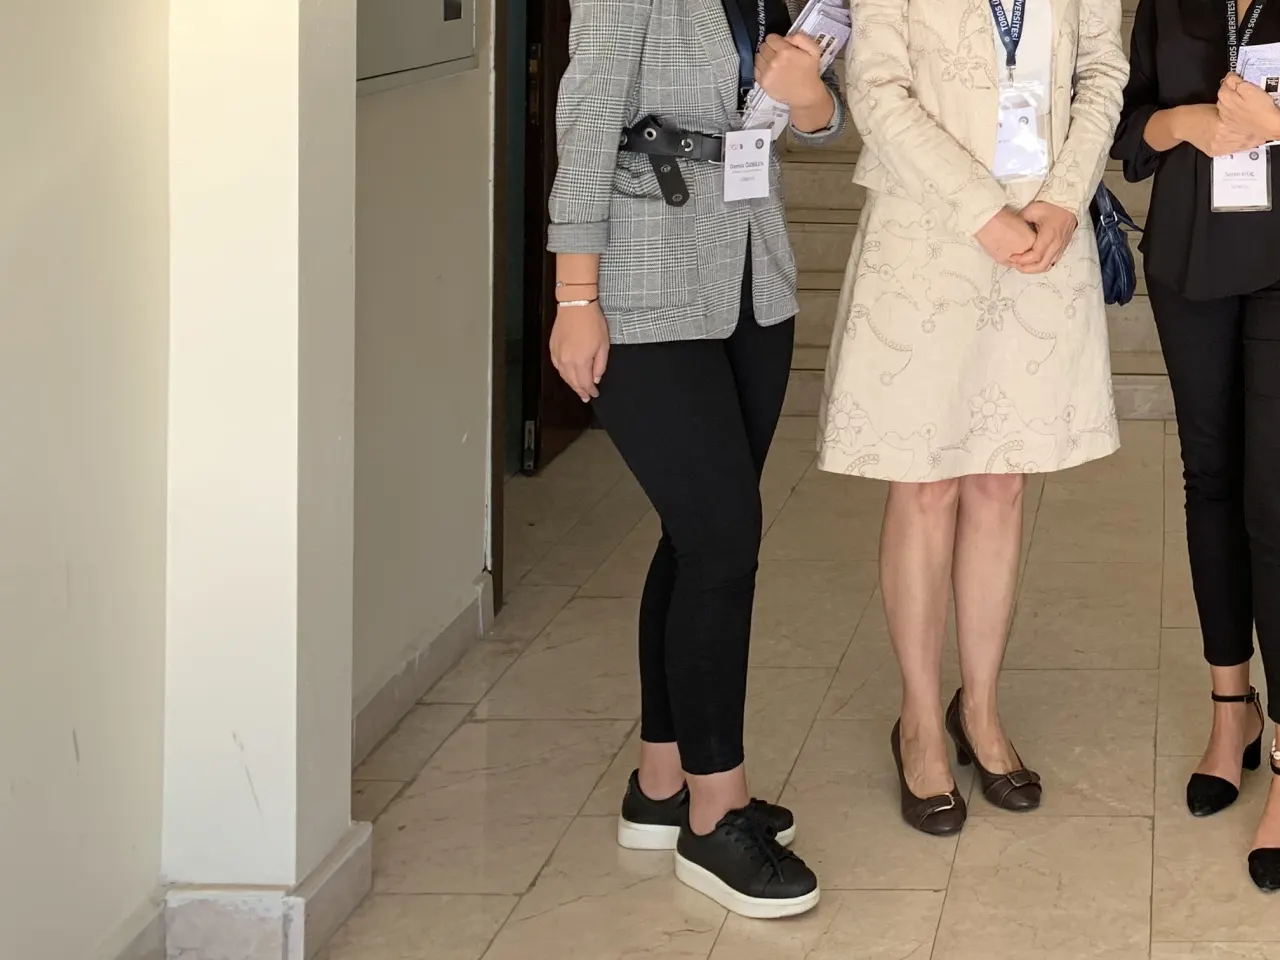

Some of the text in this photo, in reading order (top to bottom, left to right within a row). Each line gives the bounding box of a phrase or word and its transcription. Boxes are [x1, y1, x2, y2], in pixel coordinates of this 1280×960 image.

[994, 5, 1009, 32] TOROS
[1248, 4, 1263, 28] TOROS
[1226, 0, 1237, 72] TOROS ÜNİVERSİTESİ
